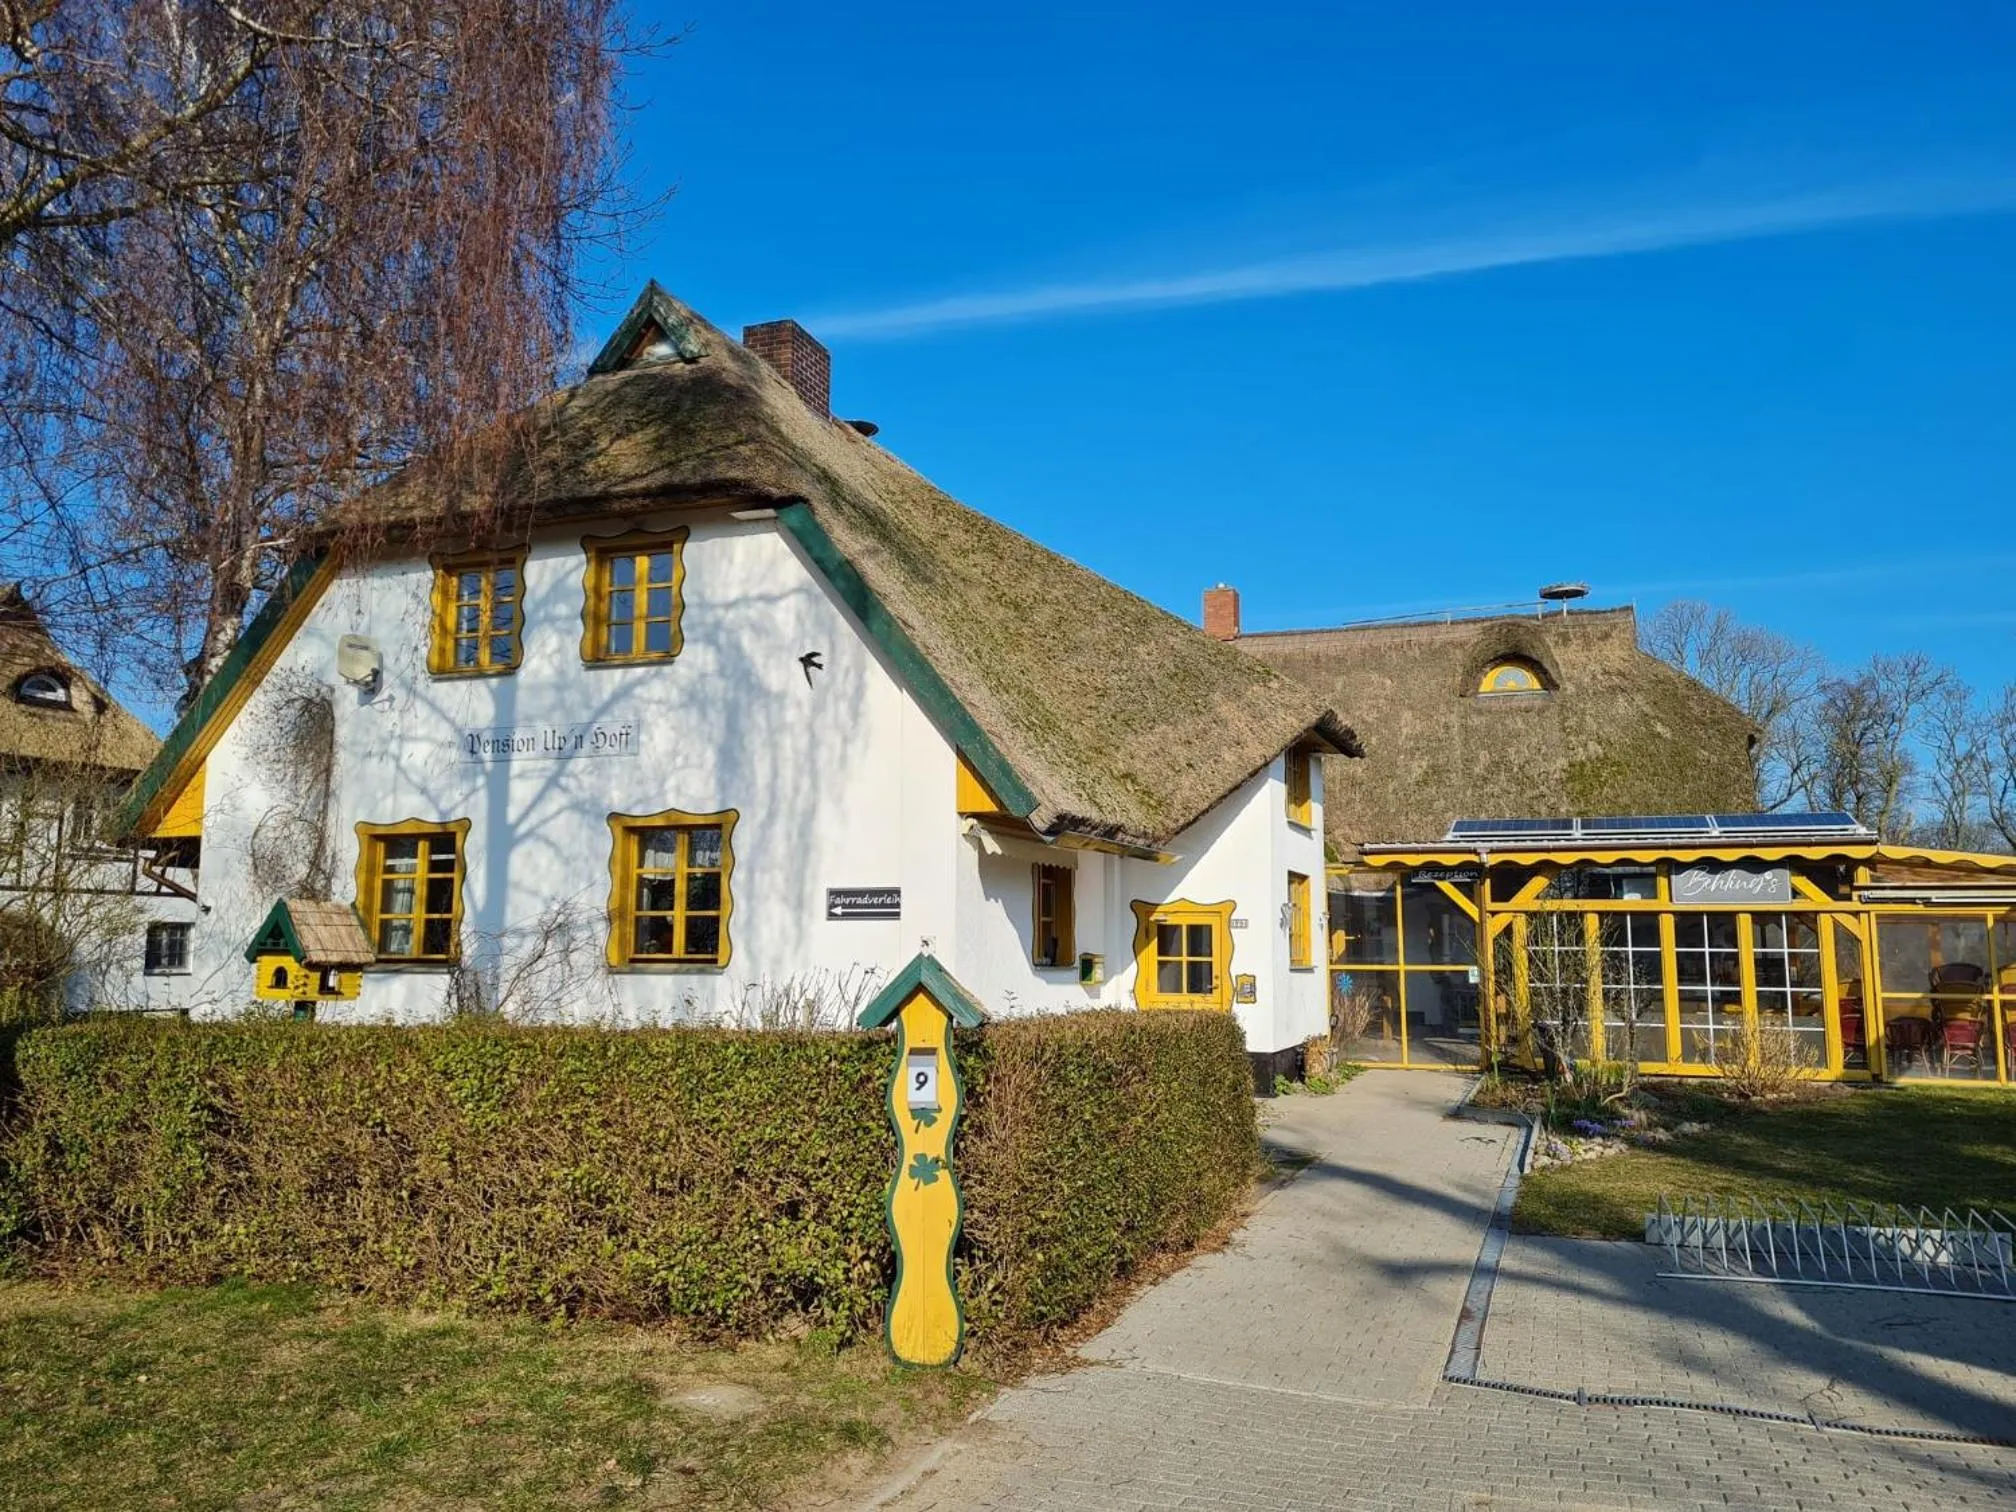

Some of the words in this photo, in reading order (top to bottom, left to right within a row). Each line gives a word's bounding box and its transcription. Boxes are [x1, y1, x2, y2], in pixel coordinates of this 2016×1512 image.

[466, 732, 536, 757] Pension
[1418, 870, 1479, 881] Rezeption
[830, 893, 902, 905] Fahrradverleih
[915, 1071, 929, 1091] 9
